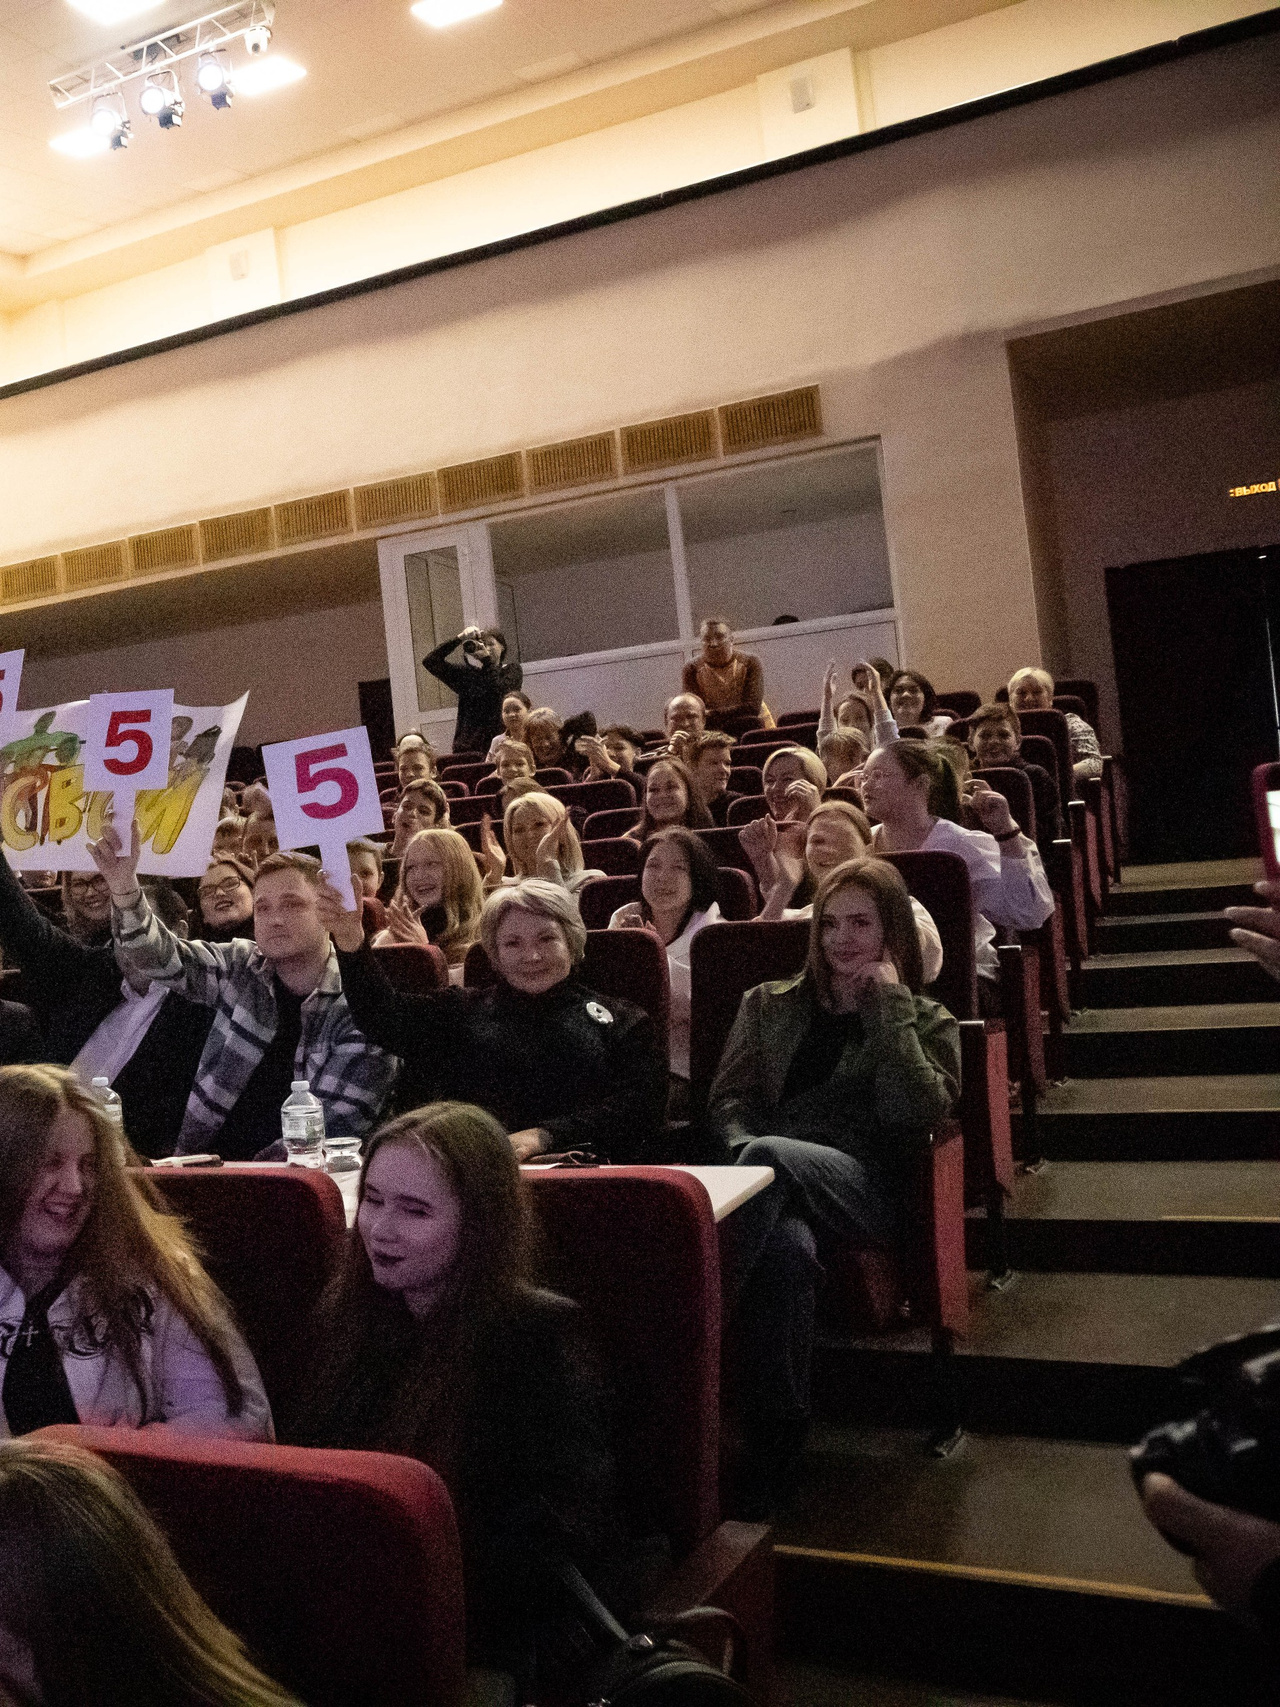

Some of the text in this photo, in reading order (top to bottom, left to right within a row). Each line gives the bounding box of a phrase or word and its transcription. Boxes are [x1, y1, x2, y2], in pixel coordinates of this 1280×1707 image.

[1235, 481, 1277, 497] ВЫХОД
[103, 709, 154, 775] 5
[294, 742, 359, 820] 5
